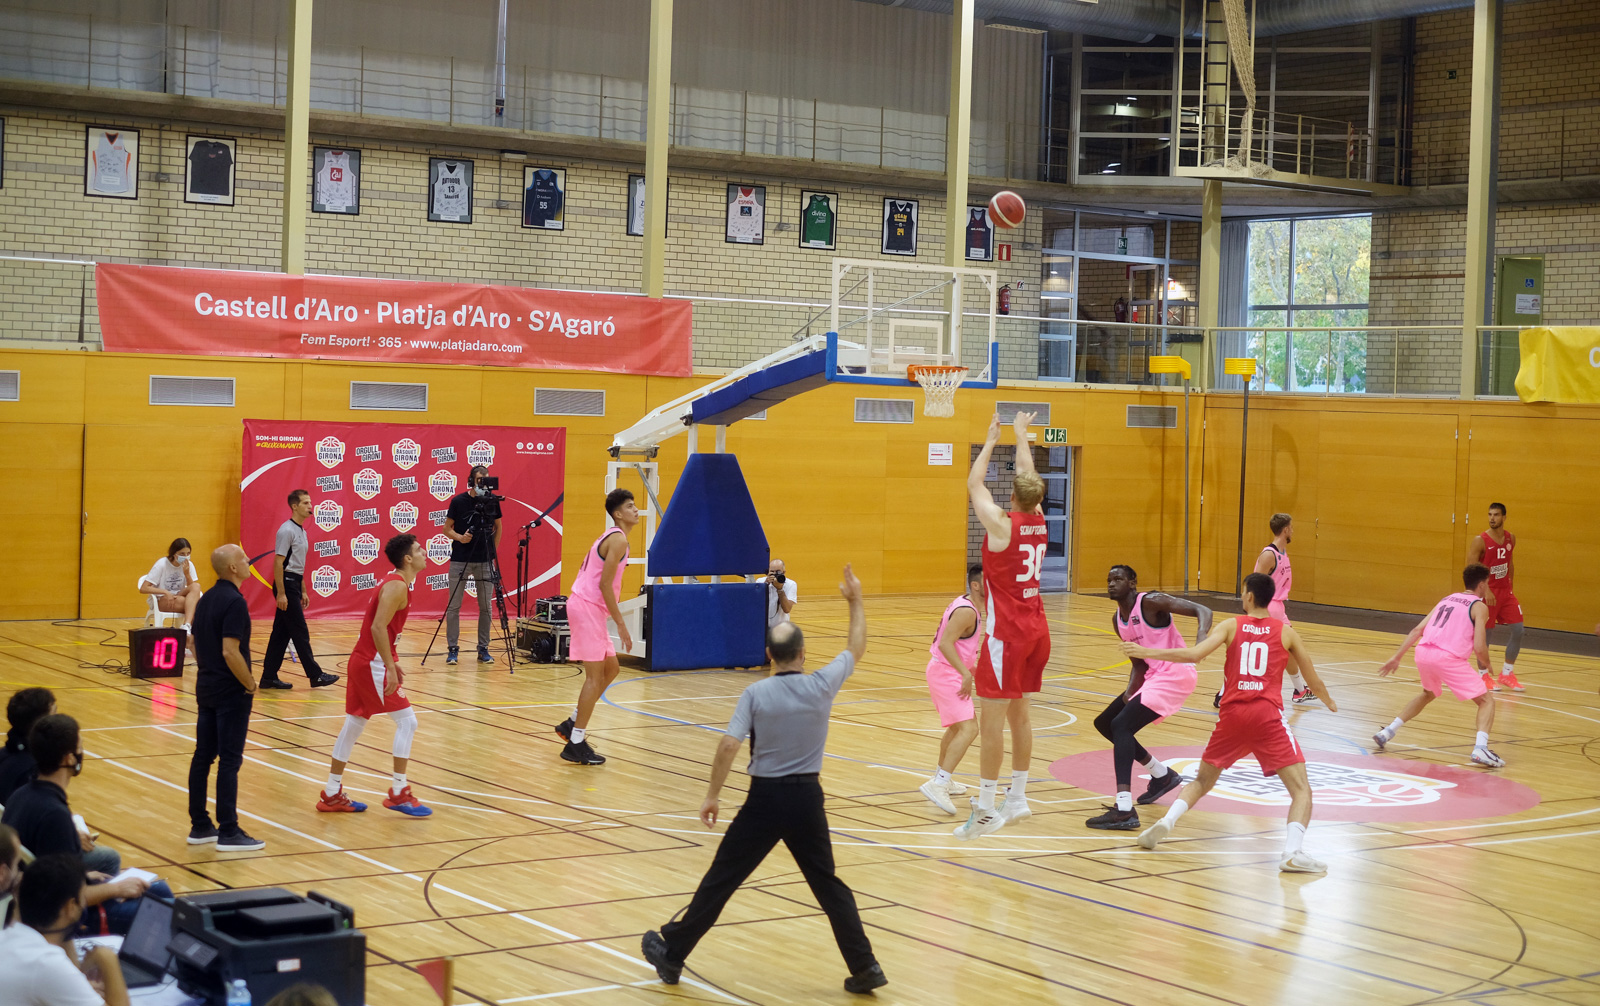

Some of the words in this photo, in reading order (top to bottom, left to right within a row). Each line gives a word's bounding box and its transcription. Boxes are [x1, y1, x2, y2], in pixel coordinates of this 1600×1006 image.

[194, 292, 287, 320] Castell
[294, 298, 358, 322] d'Aro
[377, 302, 446, 329] Platja
[452, 304, 510, 329] d'Aro
[528, 310, 615, 338] S'Agaró
[301, 334, 326, 345] Fem
[329, 335, 370, 348] Esport!
[378, 337, 402, 348] 365
[410, 339, 523, 353] www.platjadaro.com
[356, 446, 377, 455] ORGULL
[432, 448, 453, 457] ORGULL
[317, 476, 338, 485] ORGULL
[393, 478, 414, 487] ORGULL
[354, 509, 375, 518] ORGULL
[317, 516, 340, 524] GIRONA
[392, 517, 415, 525] GIRONA
[315, 541, 336, 550] ORGULL
[354, 549, 377, 557] GIRONA
[1497, 548, 1506, 559] 12
[1016, 544, 1046, 582] 30
[352, 574, 373, 583] ORGULL
[427, 575, 447, 584] ORGULL
[314, 581, 337, 589] GIRONA
[1432, 604, 1455, 628] 11
[152, 637, 178, 669] 10
[1240, 641, 1269, 677] 10
[1238, 681, 1264, 690] GIRONA
